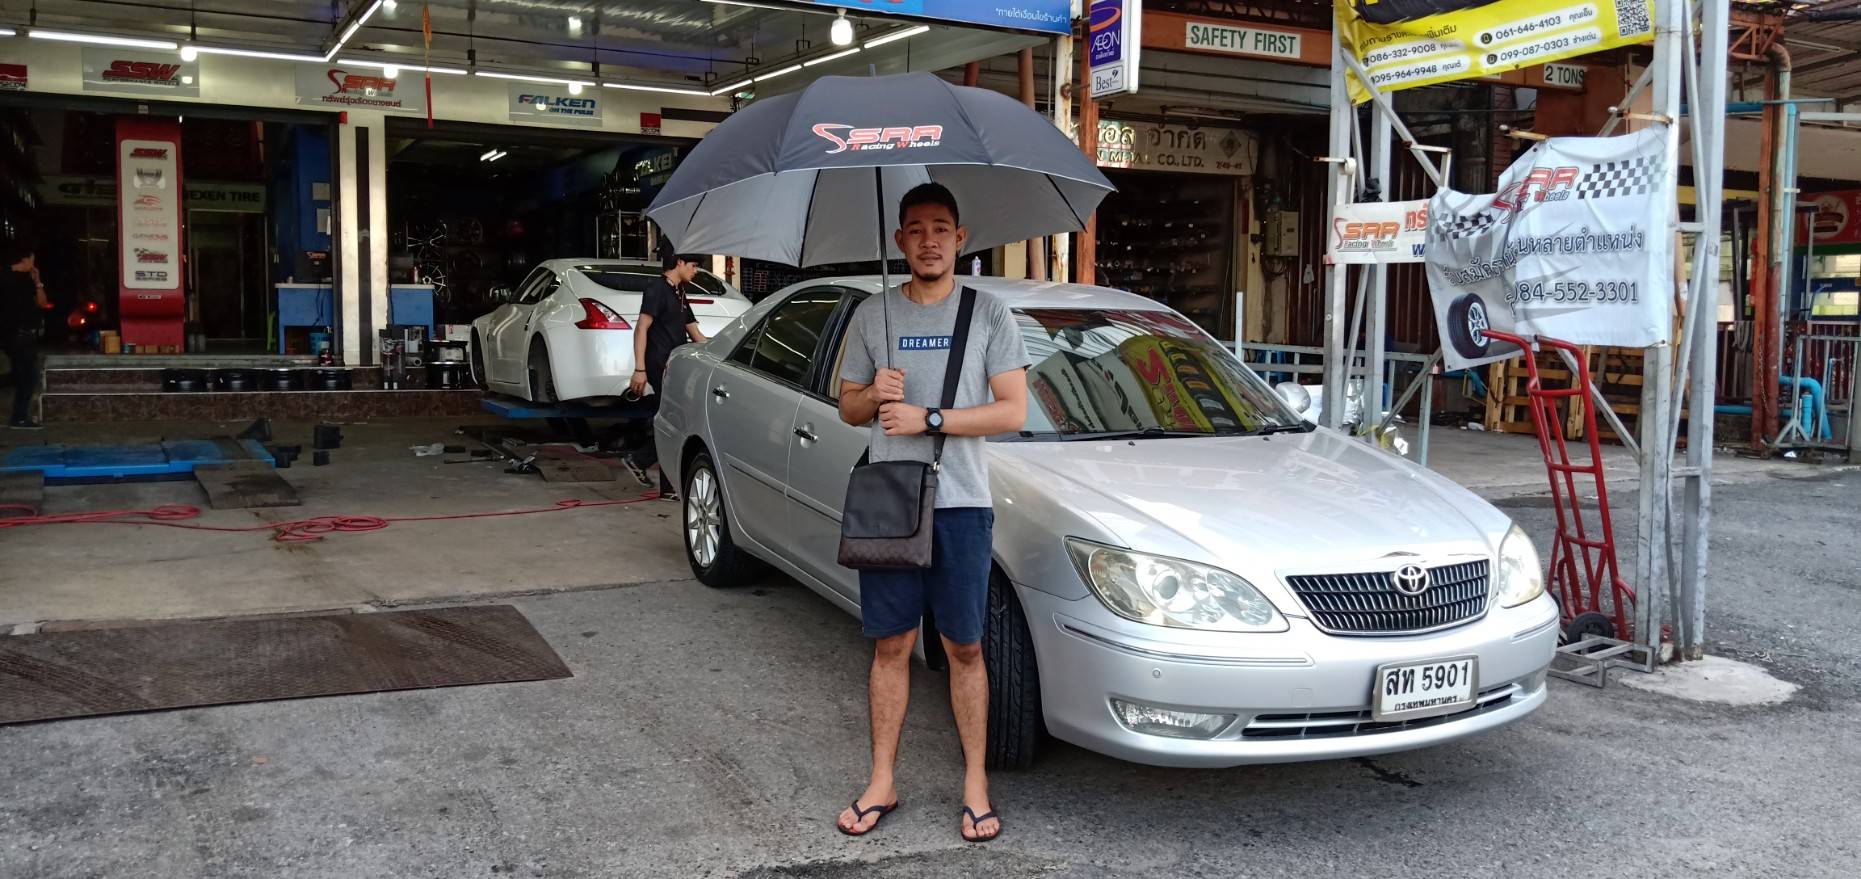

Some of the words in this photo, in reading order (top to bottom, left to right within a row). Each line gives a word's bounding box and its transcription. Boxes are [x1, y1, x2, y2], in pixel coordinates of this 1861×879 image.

[1495, 15, 1561, 40] 061-646-4103
[1191, 25, 1247, 49] SAFETY
[1255, 31, 1296, 54] FIRST
[1370, 43, 1436, 63] 086-332-9008
[1500, 38, 1569, 61] 099-087-0303
[1095, 75, 1112, 91] Best
[1545, 66, 1553, 81] 2
[1557, 67, 1585, 84] TONS
[518, 94, 595, 109] FALKEN
[851, 143, 895, 151] Racing
[896, 140, 940, 150] Wheels
[902, 338, 949, 349] DREAMER
[1386, 669, 1414, 696] สท
[1422, 661, 1468, 691] 5901
